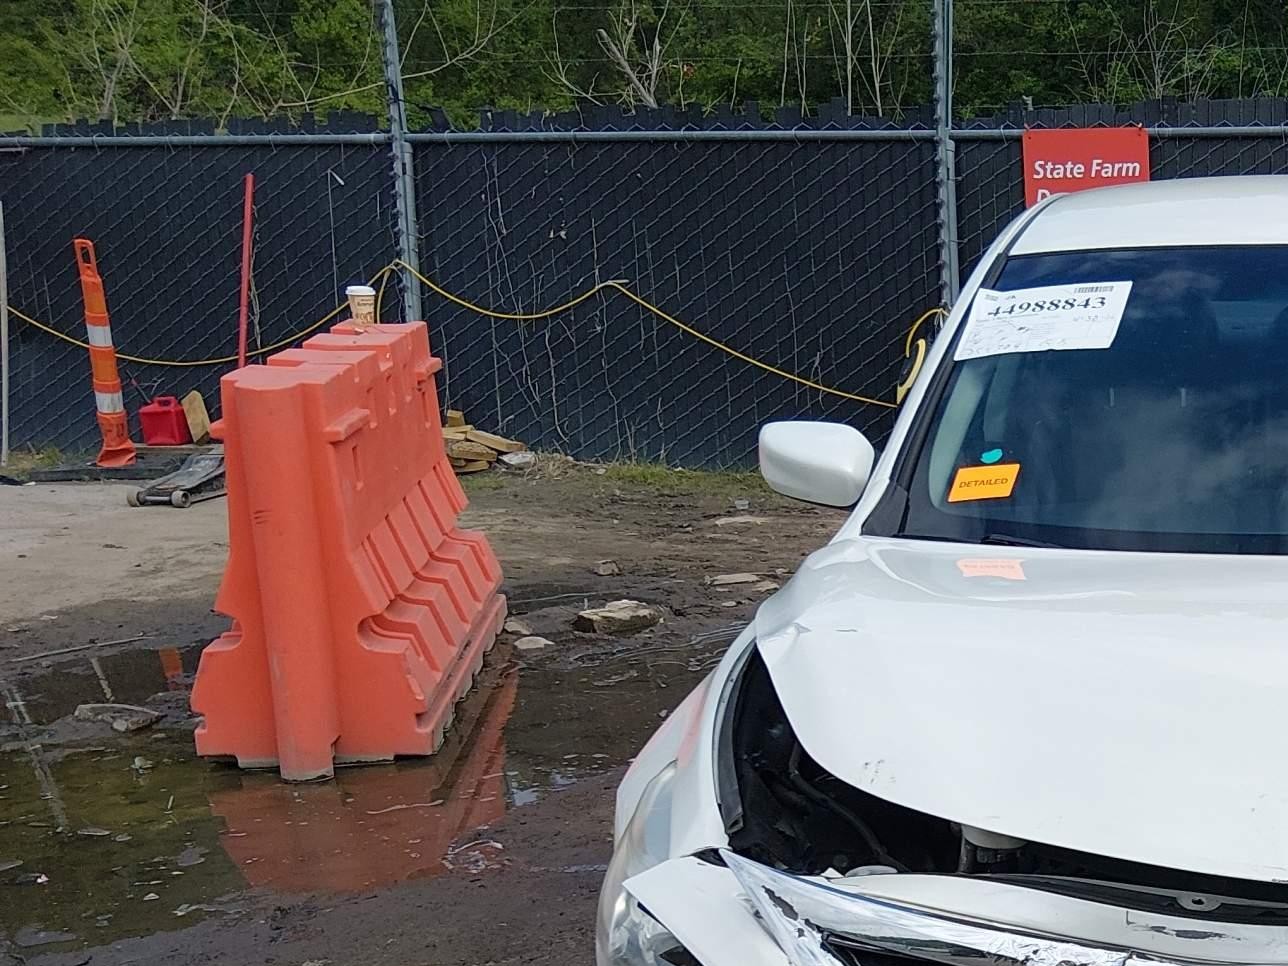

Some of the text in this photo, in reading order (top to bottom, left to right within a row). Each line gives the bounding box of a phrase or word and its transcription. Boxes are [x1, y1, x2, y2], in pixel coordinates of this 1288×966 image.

[1032, 159, 1141, 179] State Farm
[987, 296, 1107, 317] 44988843
[959, 478, 1009, 489] DETAILED
